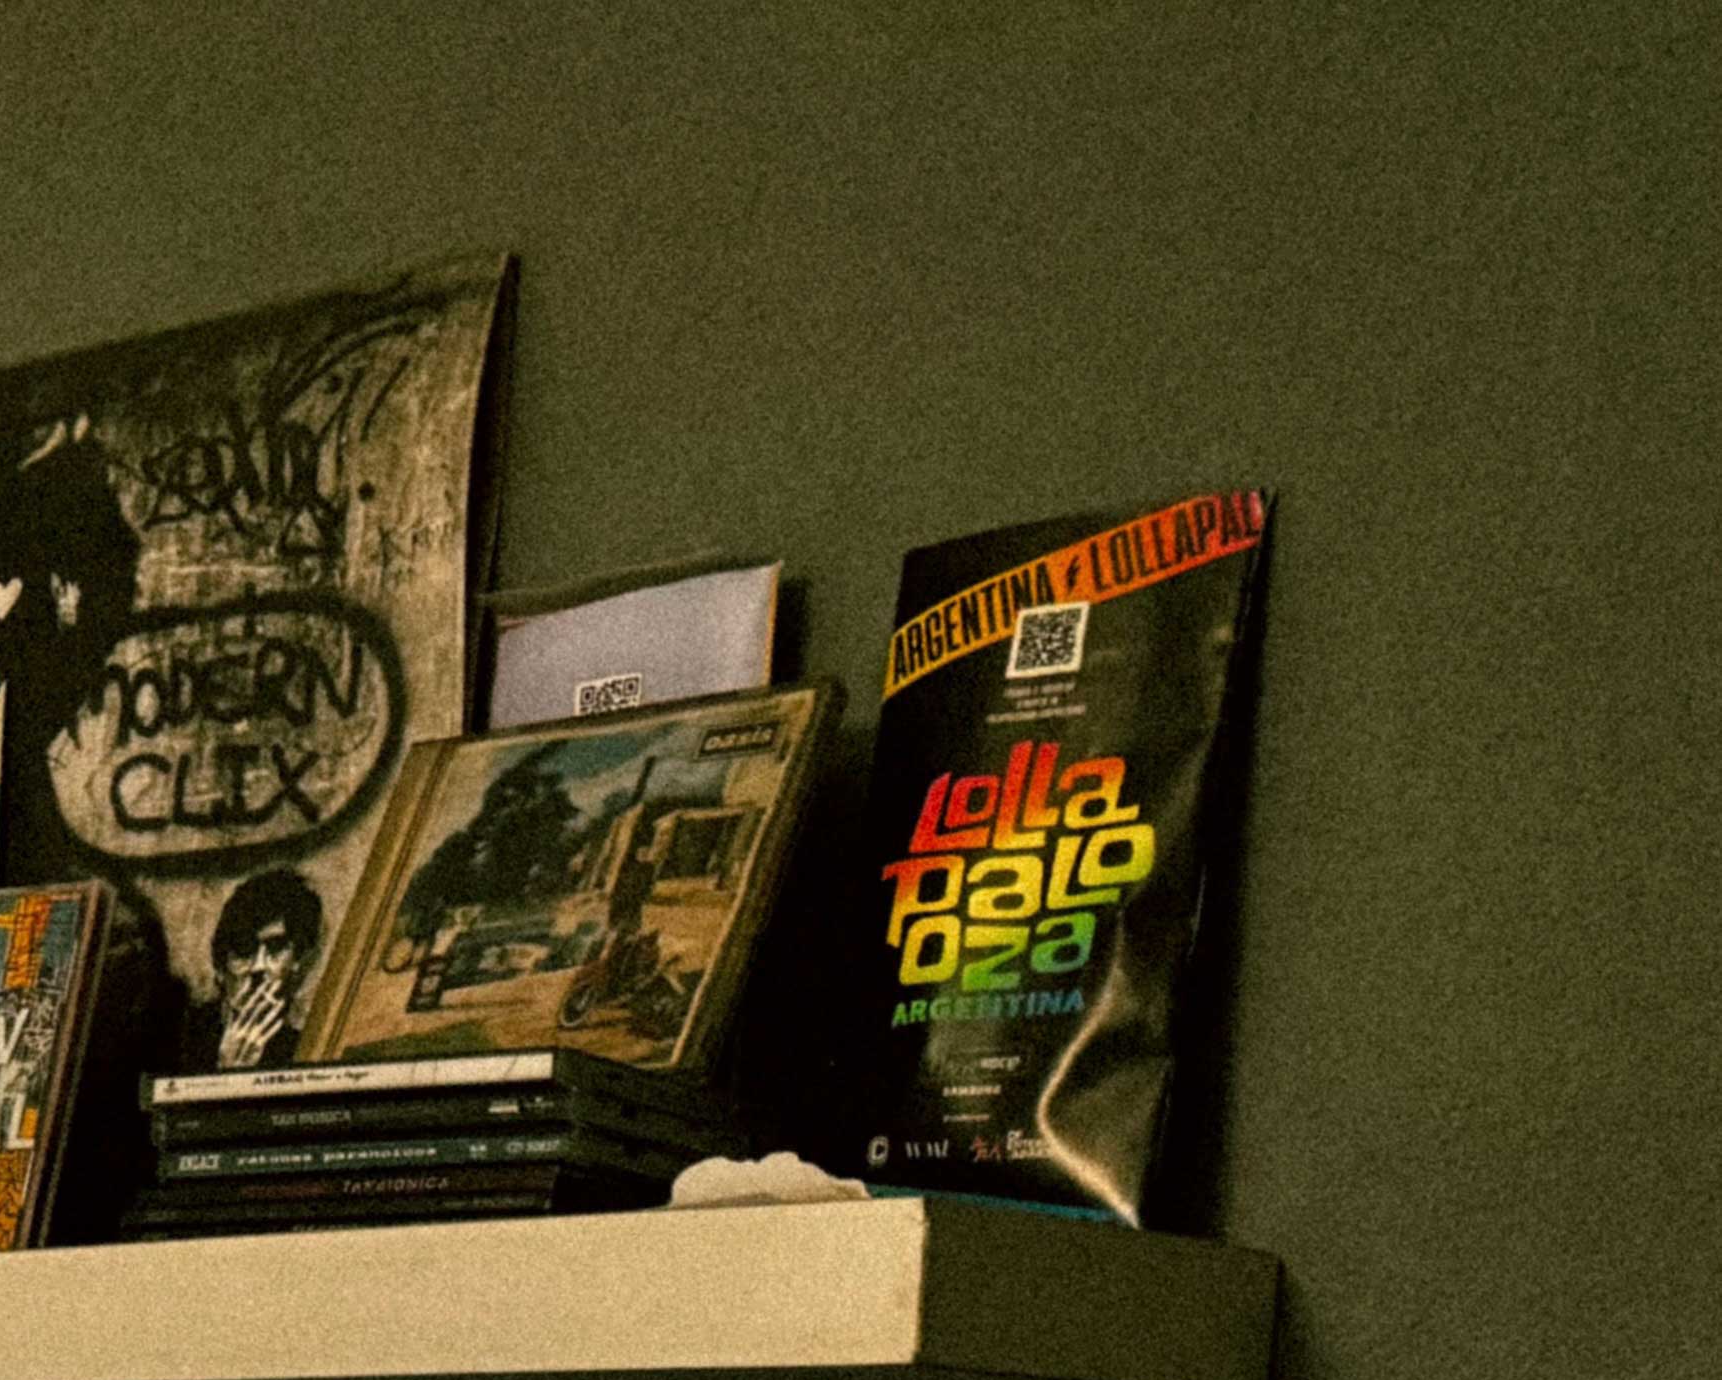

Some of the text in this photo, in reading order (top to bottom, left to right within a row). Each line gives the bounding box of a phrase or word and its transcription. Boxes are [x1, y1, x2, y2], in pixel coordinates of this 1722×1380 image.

[892, 559, 1050, 684] ARGENTINA
[882, 823, 1155, 948] palo
[899, 912, 1096, 991] oza
[892, 989, 1085, 1027] ARGENTINA
